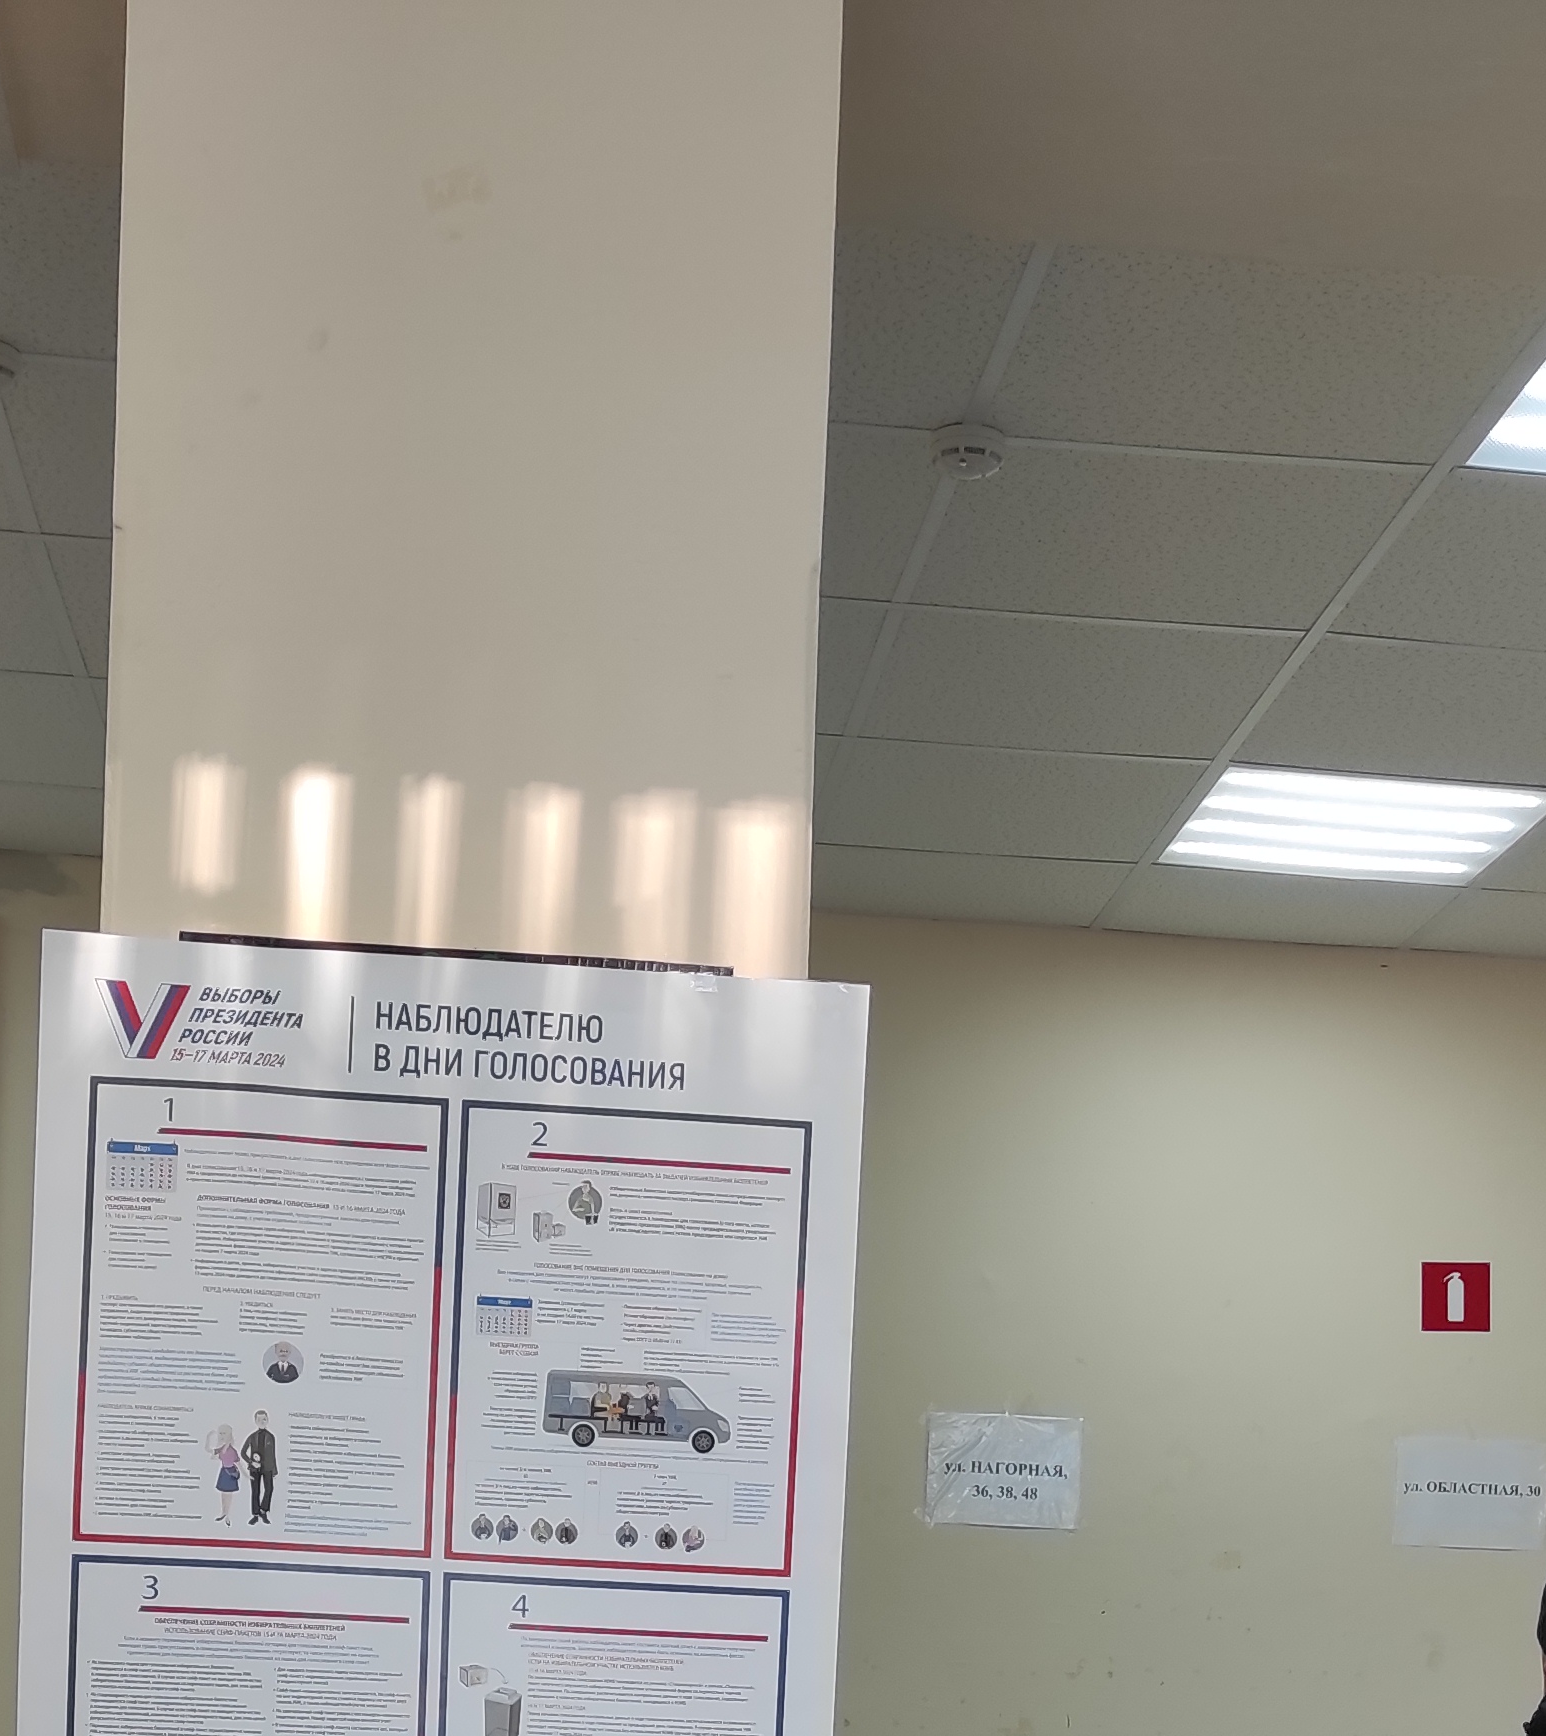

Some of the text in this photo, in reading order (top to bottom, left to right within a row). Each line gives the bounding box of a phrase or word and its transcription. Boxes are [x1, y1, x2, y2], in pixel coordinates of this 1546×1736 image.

[197, 986, 281, 1006] ВЫБОРЫ
[188, 1006, 304, 1029] ПРЕЗИДЕНТА
[375, 1000, 604, 1044] НАБЛЮДАТЕЛЮ
[177, 1028, 253, 1047] РОССИИ
[207, 1050, 253, 1067] МАРТА
[253, 1052, 287, 1069] 2024
[373, 1043, 687, 1091] В ДНИ ГОЛОСОВАНИЯ
[162, 1097, 175, 1123] 1
[530, 1121, 549, 1147] 2
[944, 1460, 1068, 1480] ул. НАГОРНАЯ,
[971, 1484, 1038, 1501] 36, 38, 48
[1403, 1481, 1541, 1498] ул. ОБЛАСТНАЯ, 30
[140, 1575, 160, 1600] 3
[511, 1594, 529, 1618] 4
